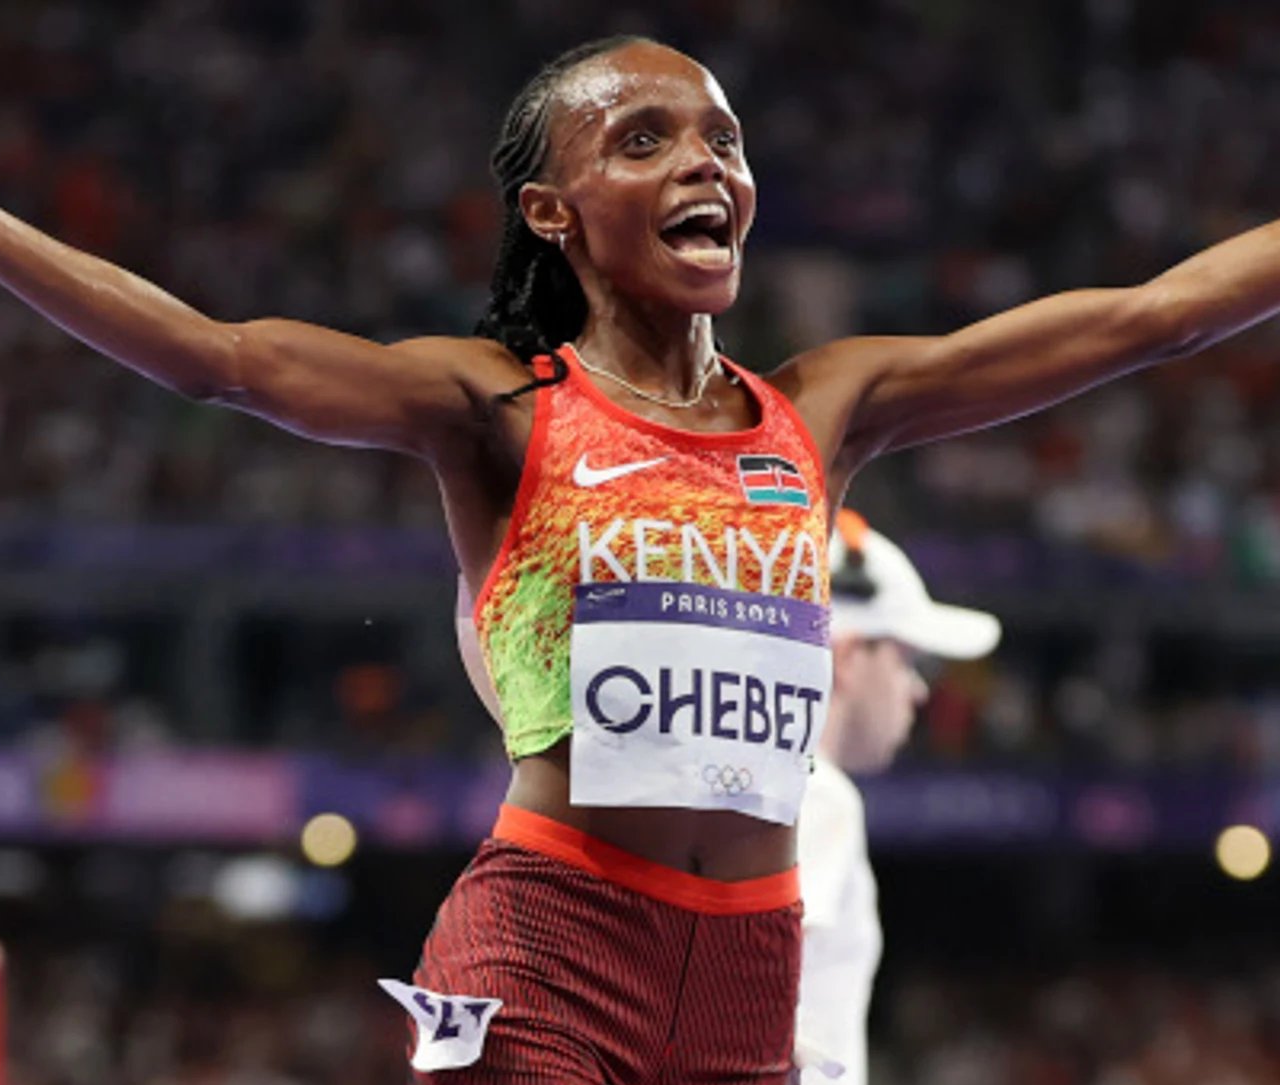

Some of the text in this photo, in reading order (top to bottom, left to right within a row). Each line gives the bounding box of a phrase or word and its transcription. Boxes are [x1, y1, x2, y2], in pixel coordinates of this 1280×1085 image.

[578, 518, 821, 604] KENYA
[660, 592, 791, 627] PARIS 2024
[586, 665, 823, 754] CHEBET
